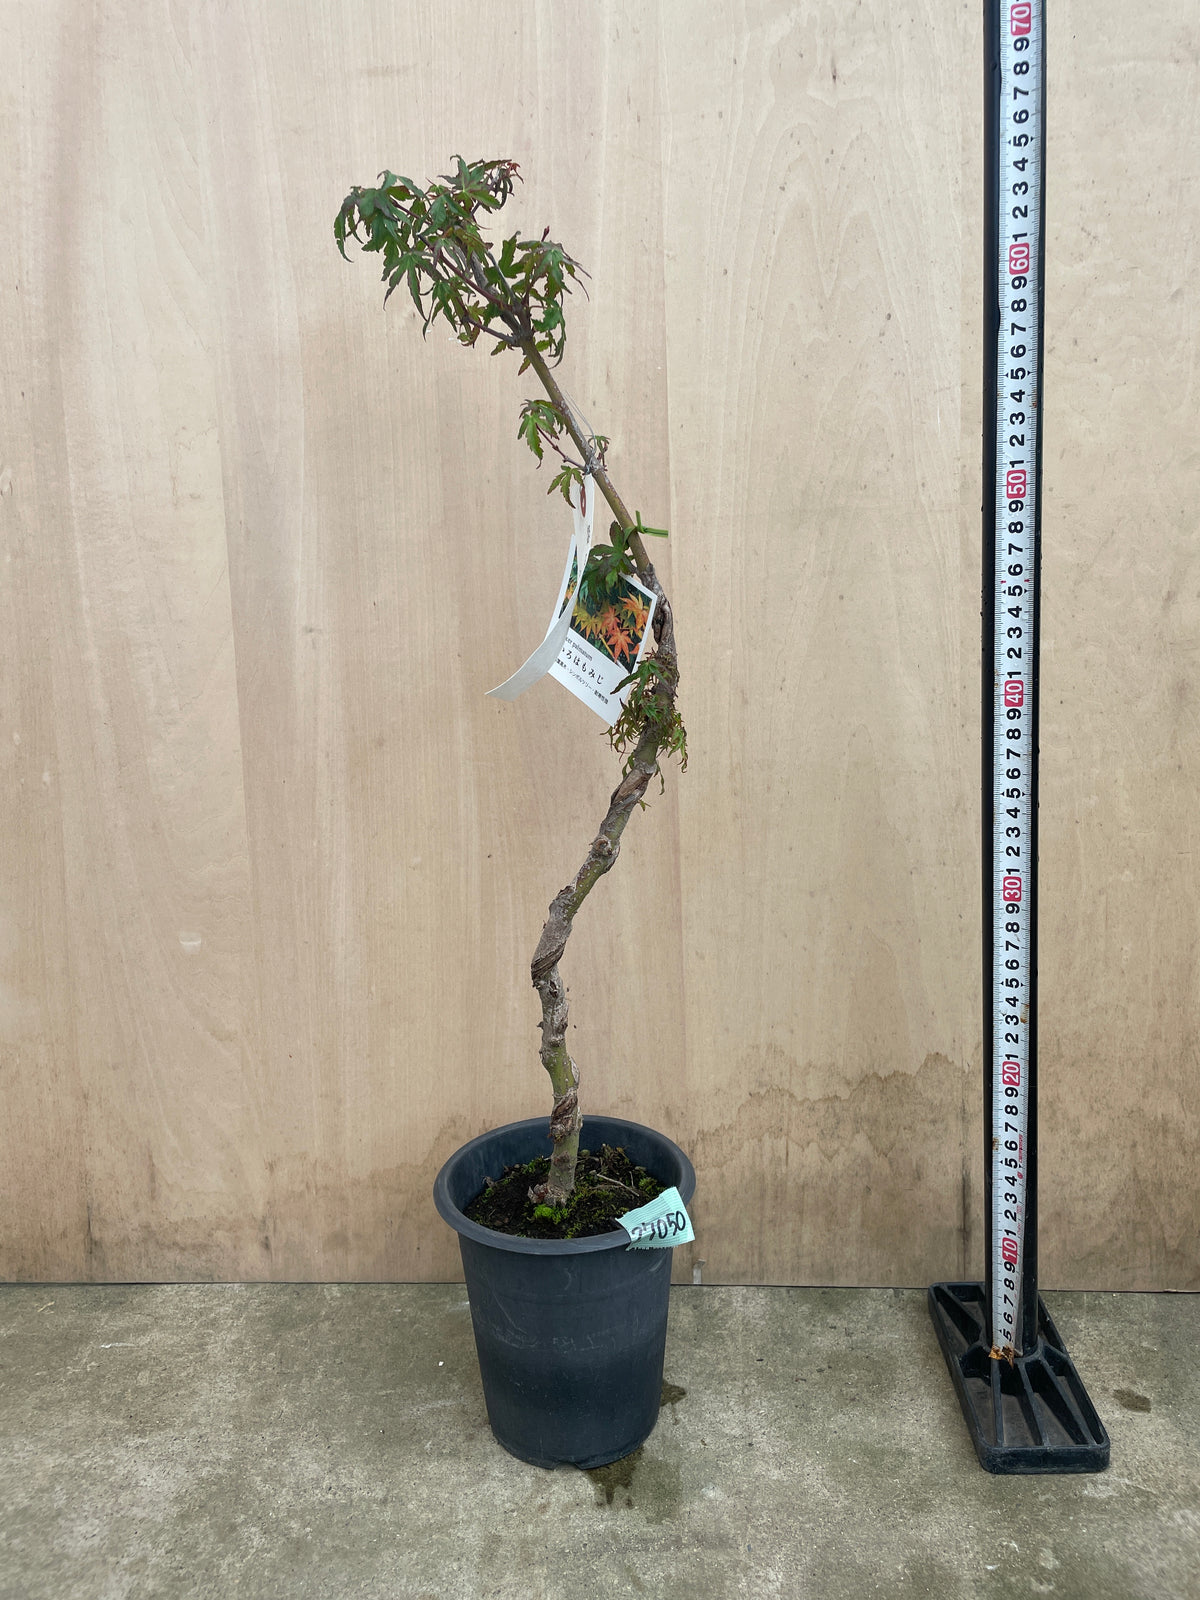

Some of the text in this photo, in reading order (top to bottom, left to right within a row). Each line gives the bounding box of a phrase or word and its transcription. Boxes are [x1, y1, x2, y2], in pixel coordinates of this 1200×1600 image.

[1012, 5, 1030, 33] 70
[1014, 37, 1030, 51] 9
[1013, 61, 1029, 75] 8
[1013, 87, 1029, 100] 7
[1013, 109, 1029, 124] 6
[1013, 134, 1029, 147] 5
[1013, 157, 1028, 171] 4
[1013, 182, 1028, 195] 3
[1012, 205, 1028, 219] 2
[1011, 247, 1028, 270] 60
[1012, 276, 1027, 289] 9
[1011, 299, 1027, 312] 8
[1011, 323, 1026, 335] 7
[1011, 345, 1026, 358] 6
[1010, 367, 1025, 380] 5
[1010, 389, 1025, 403] 4
[1010, 412, 1025, 425] 3
[1009, 434, 1024, 447] 2
[1008, 473, 1025, 496] 50
[1009, 500, 1024, 513] 9
[1008, 521, 1023, 534] 8
[1008, 543, 1023, 555] 7
[1008, 564, 1023, 577] 6
[1008, 585, 1022, 597] 5
[1008, 606, 1022, 618] 4
[1007, 627, 1022, 638] 3
[1007, 647, 1022, 659] 2
[1006, 683, 1022, 705] 40
[1007, 708, 1021, 720] 9
[1006, 728, 1021, 740] 8
[1007, 748, 1021, 759] 7
[1006, 768, 1021, 780] 6
[1006, 788, 1021, 799] 5
[1006, 807, 1020, 819] 4
[1006, 827, 1020, 838] 3
[1006, 846, 1020, 857] 2
[1004, 879, 1021, 899] 30
[1006, 903, 1020, 914] 9
[1005, 922, 1020, 933] 8
[1005, 941, 1020, 951] 7
[1005, 959, 1019, 970] 6
[1005, 978, 1019, 989] 5
[1005, 997, 1019, 1008] 4
[1004, 1014, 1019, 1025] 3
[1005, 1033, 1018, 1044] 2
[1004, 1064, 1020, 1084] 20
[1005, 1087, 1019, 1098] 9
[1005, 1105, 1018, 1116] 8
[1005, 1122, 1018, 1133] 7
[1005, 1140, 1018, 1151] 6
[1005, 1158, 1018, 1169] 5
[1005, 1175, 1017, 1187] 4
[1004, 1193, 1017, 1204] 3
[1004, 1209, 1017, 1222] 2
[1003, 1241, 1017, 1261] 10
[1004, 1261, 1015, 1273] 9
[1004, 1278, 1015, 1290] 8
[1004, 1294, 1014, 1307] 7
[1003, 1312, 1013, 1324] 6
[1003, 1329, 1012, 1342] 5
